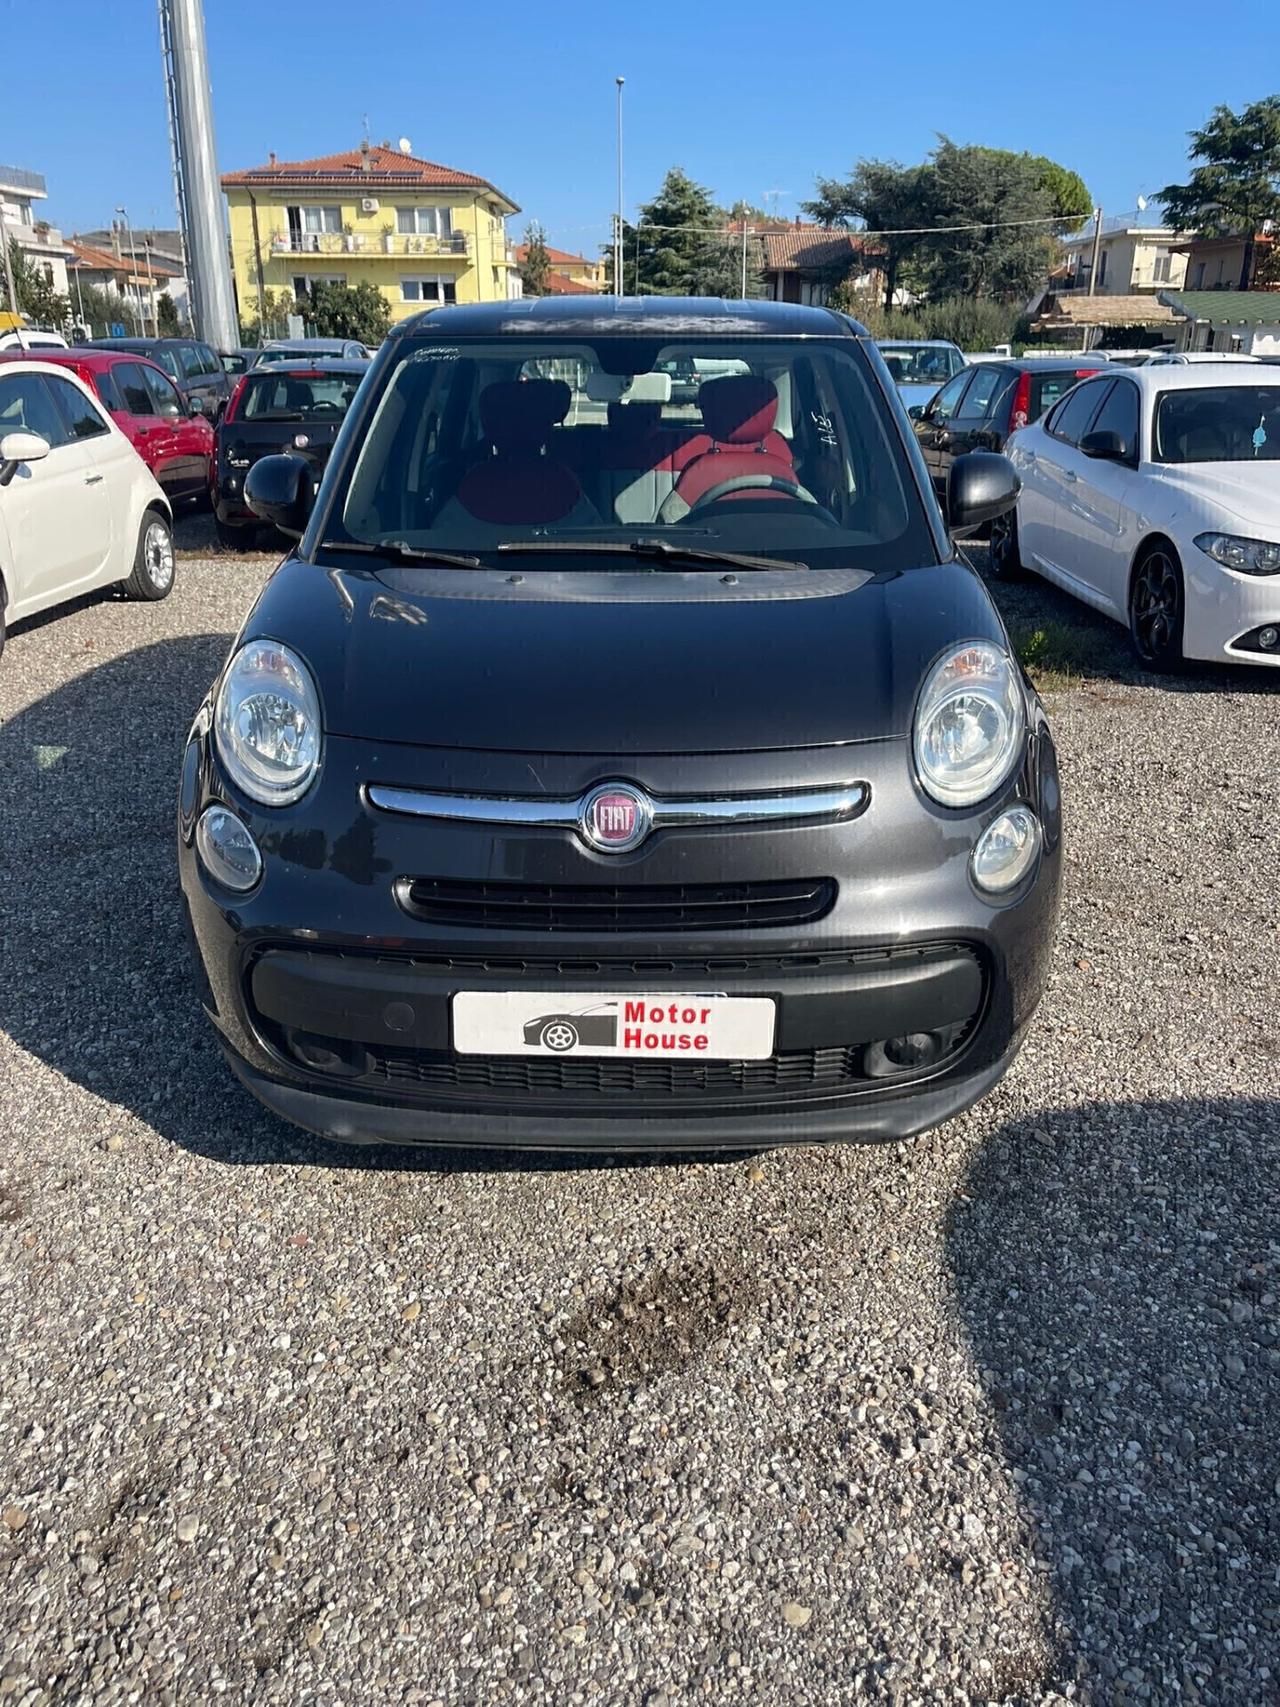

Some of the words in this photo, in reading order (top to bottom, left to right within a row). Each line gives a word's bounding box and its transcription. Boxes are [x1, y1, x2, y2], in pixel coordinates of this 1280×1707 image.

[600, 805, 633, 831] FIAT
[624, 1001, 712, 1024] Motor
[624, 1028, 709, 1050] House
